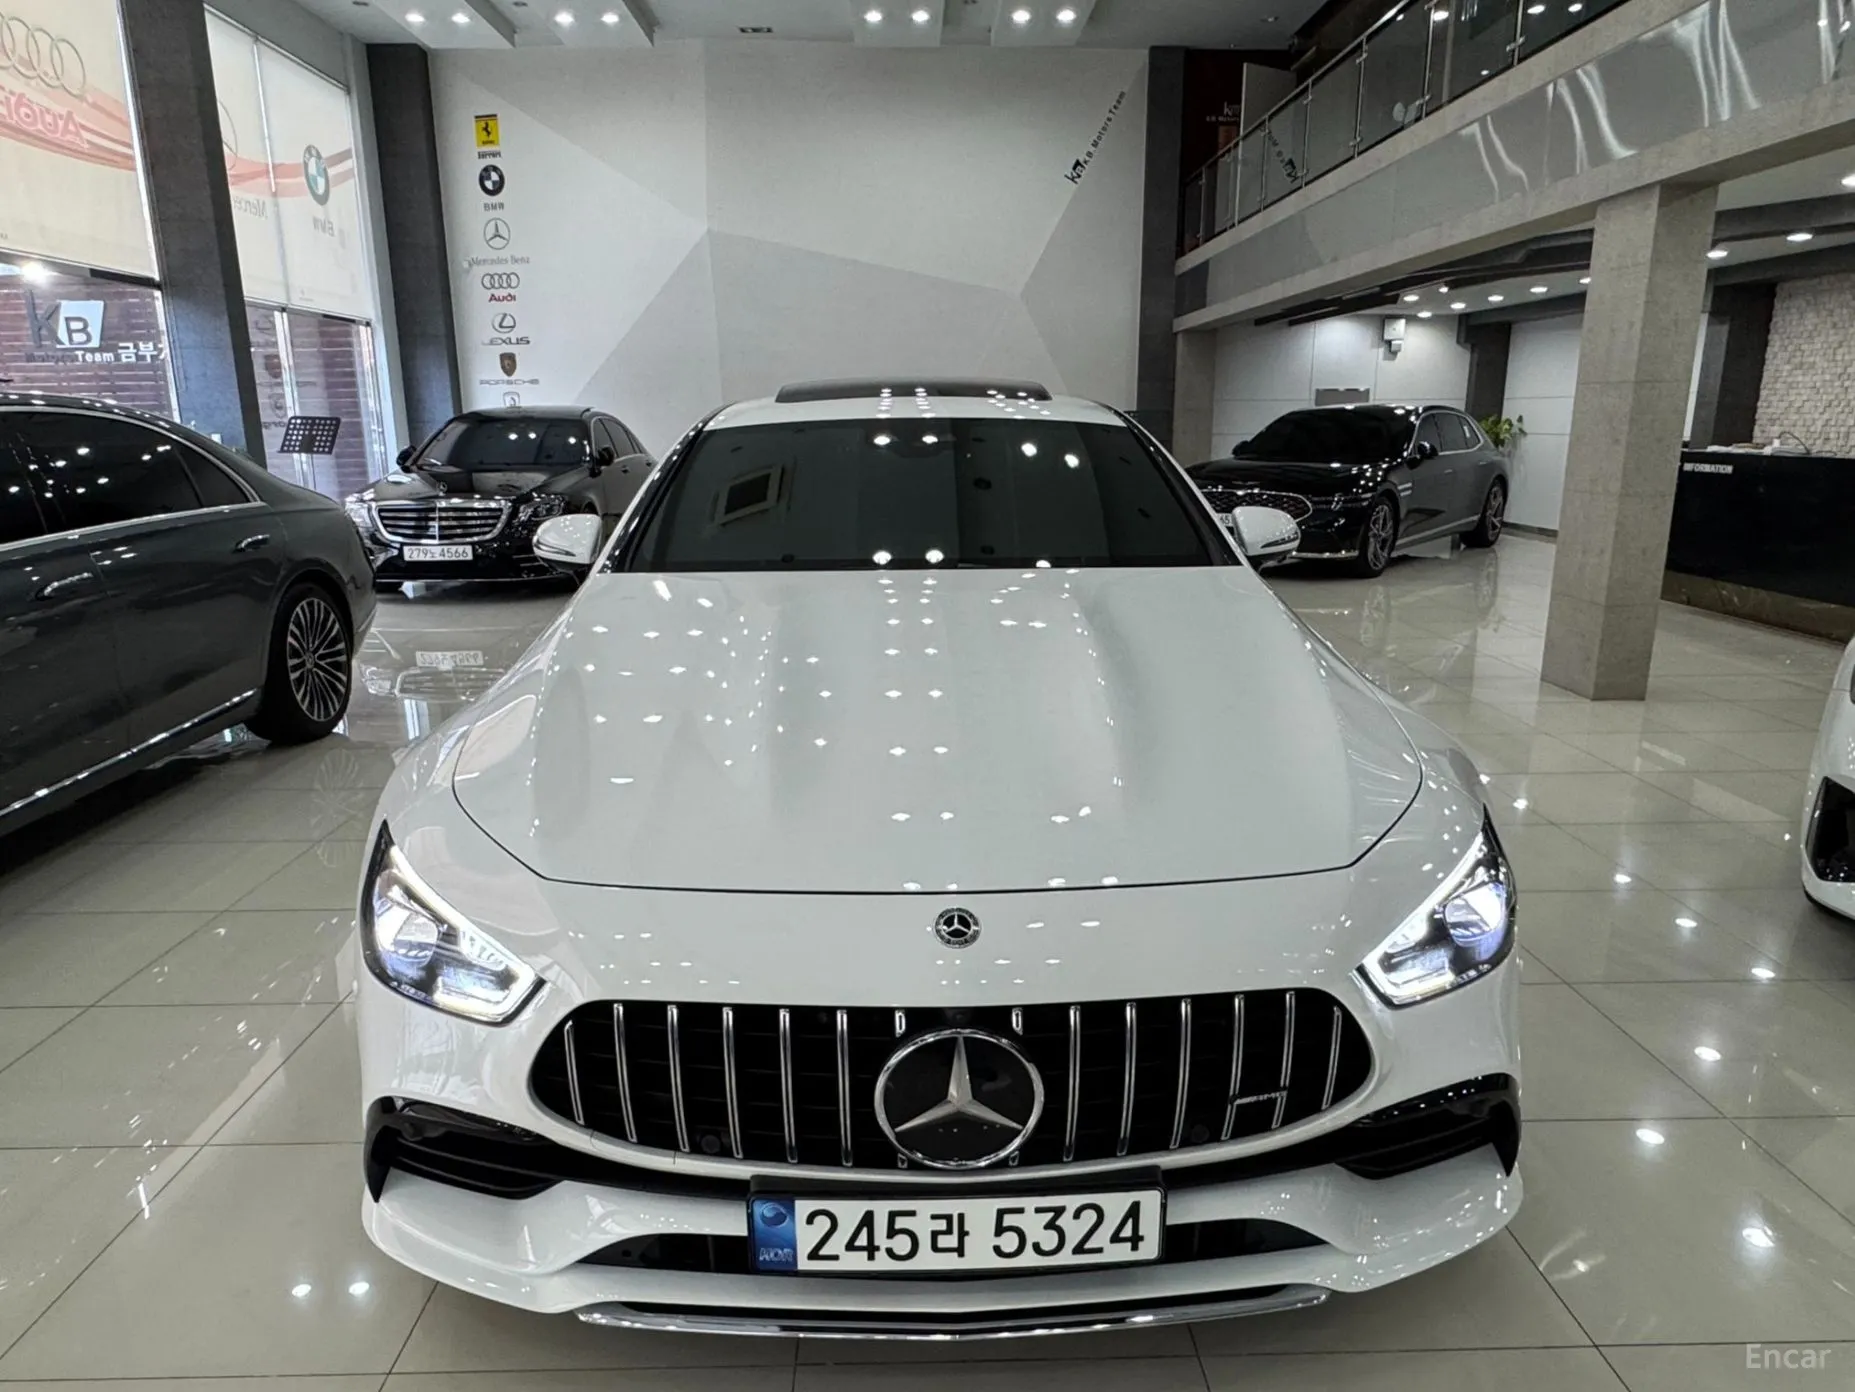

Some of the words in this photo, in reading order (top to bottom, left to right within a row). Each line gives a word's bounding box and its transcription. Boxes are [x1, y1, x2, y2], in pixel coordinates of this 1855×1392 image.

[1091, 117, 1113, 148] Motors
[1108, 91, 1127, 116] Team
[484, 202, 505, 212] BMW
[511, 254, 530, 265] Benz
[488, 293, 517, 303] Audi
[481, 337, 531, 346] LEXUS
[75, 351, 115, 363] Team
[1683, 463, 1733, 474] INFORMATION
[439, 547, 469, 559] 4566
[805, 1208, 970, 1262] 245라
[992, 1200, 1144, 1259] 5324
